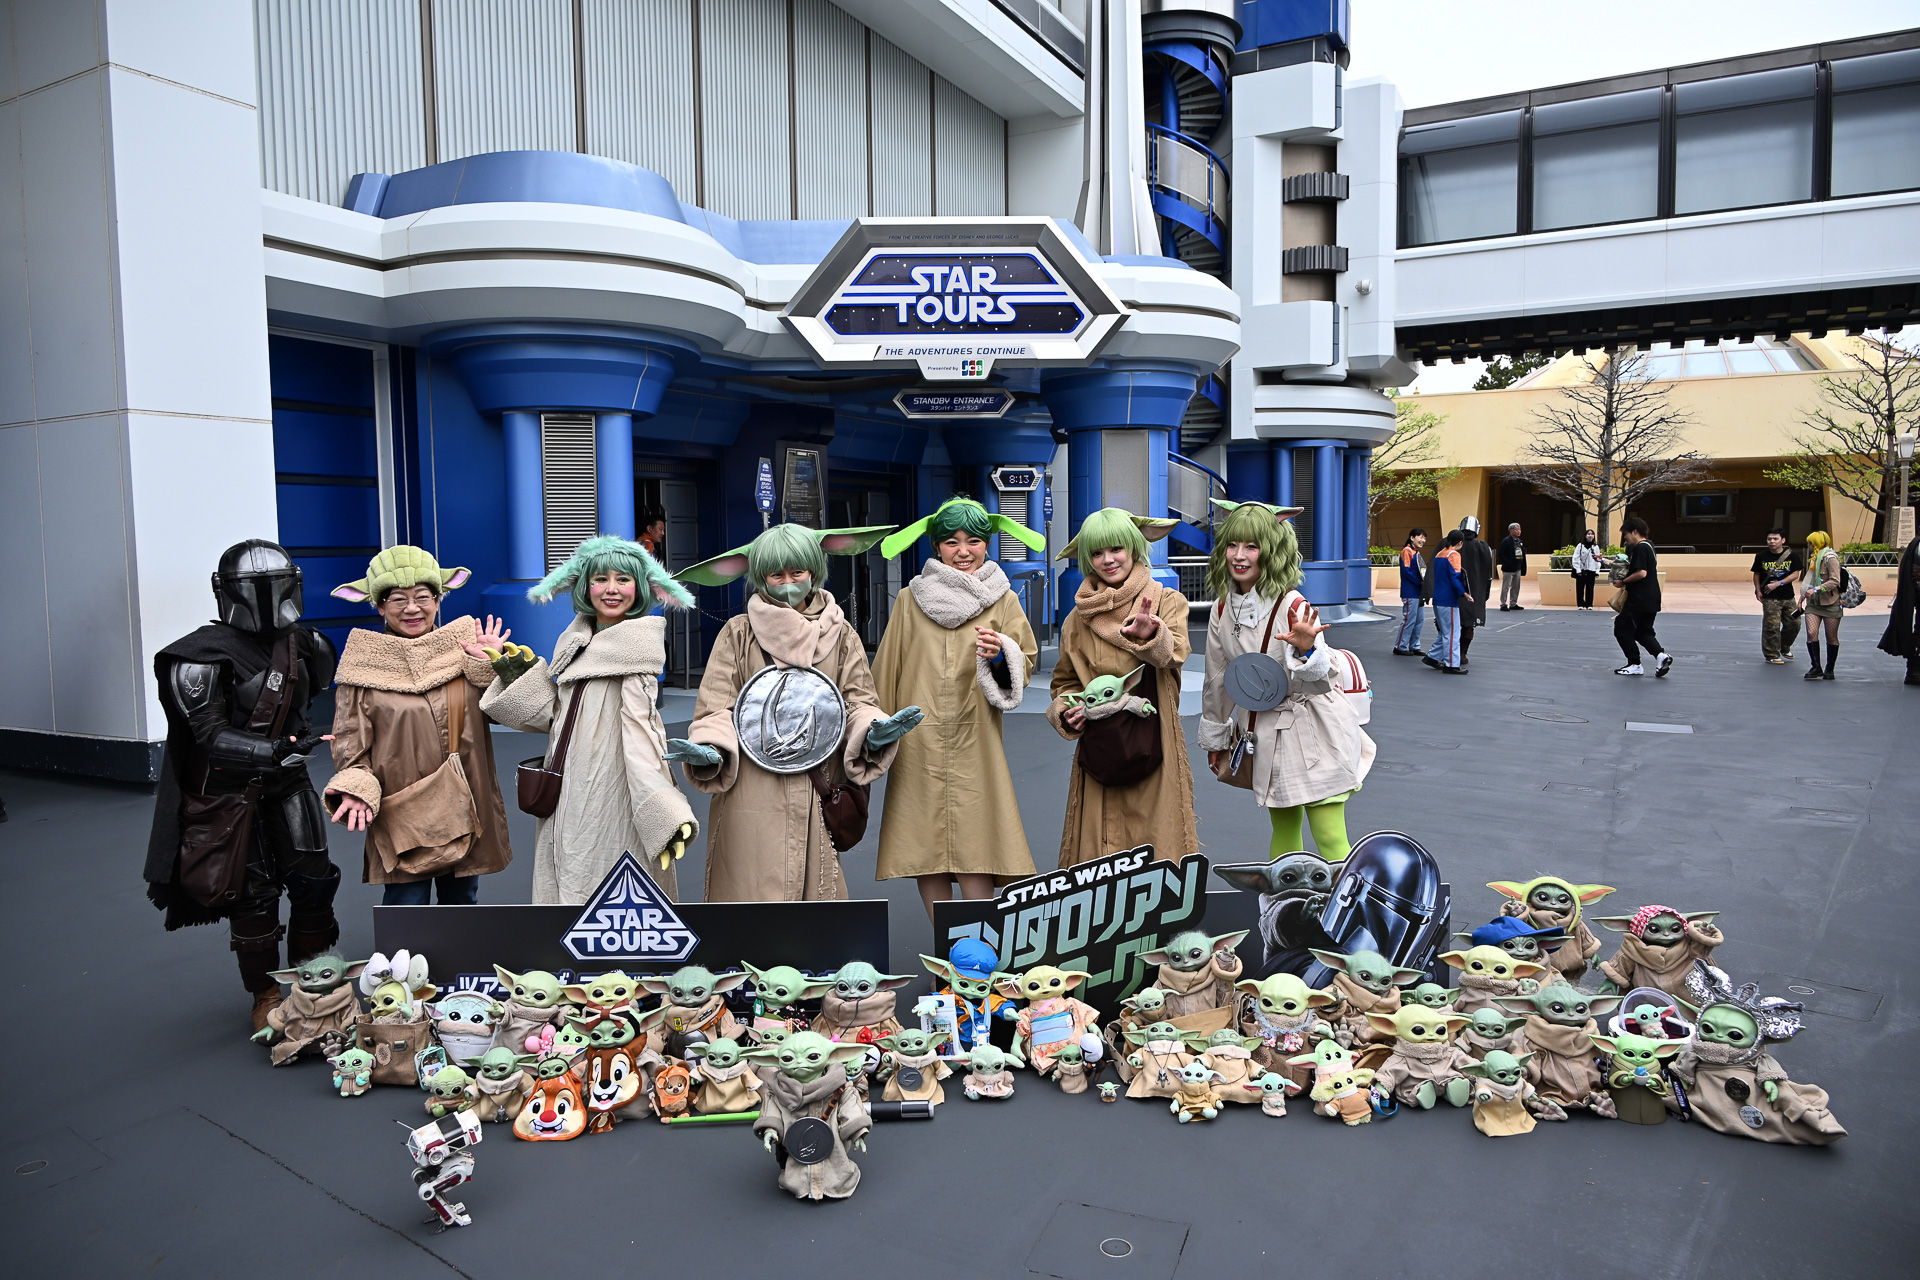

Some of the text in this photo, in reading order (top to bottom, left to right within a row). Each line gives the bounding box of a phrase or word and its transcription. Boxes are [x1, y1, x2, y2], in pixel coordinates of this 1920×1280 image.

[908, 265, 1000, 293] STAR
[891, 295, 1017, 323] TOURS
[962, 362, 982, 374] JCB
[1008, 475, 1030, 484] 8:13
[997, 851, 1149, 909] STAR WARS
[582, 909, 676, 929] STAR
[577, 930, 684, 952] TOURS
